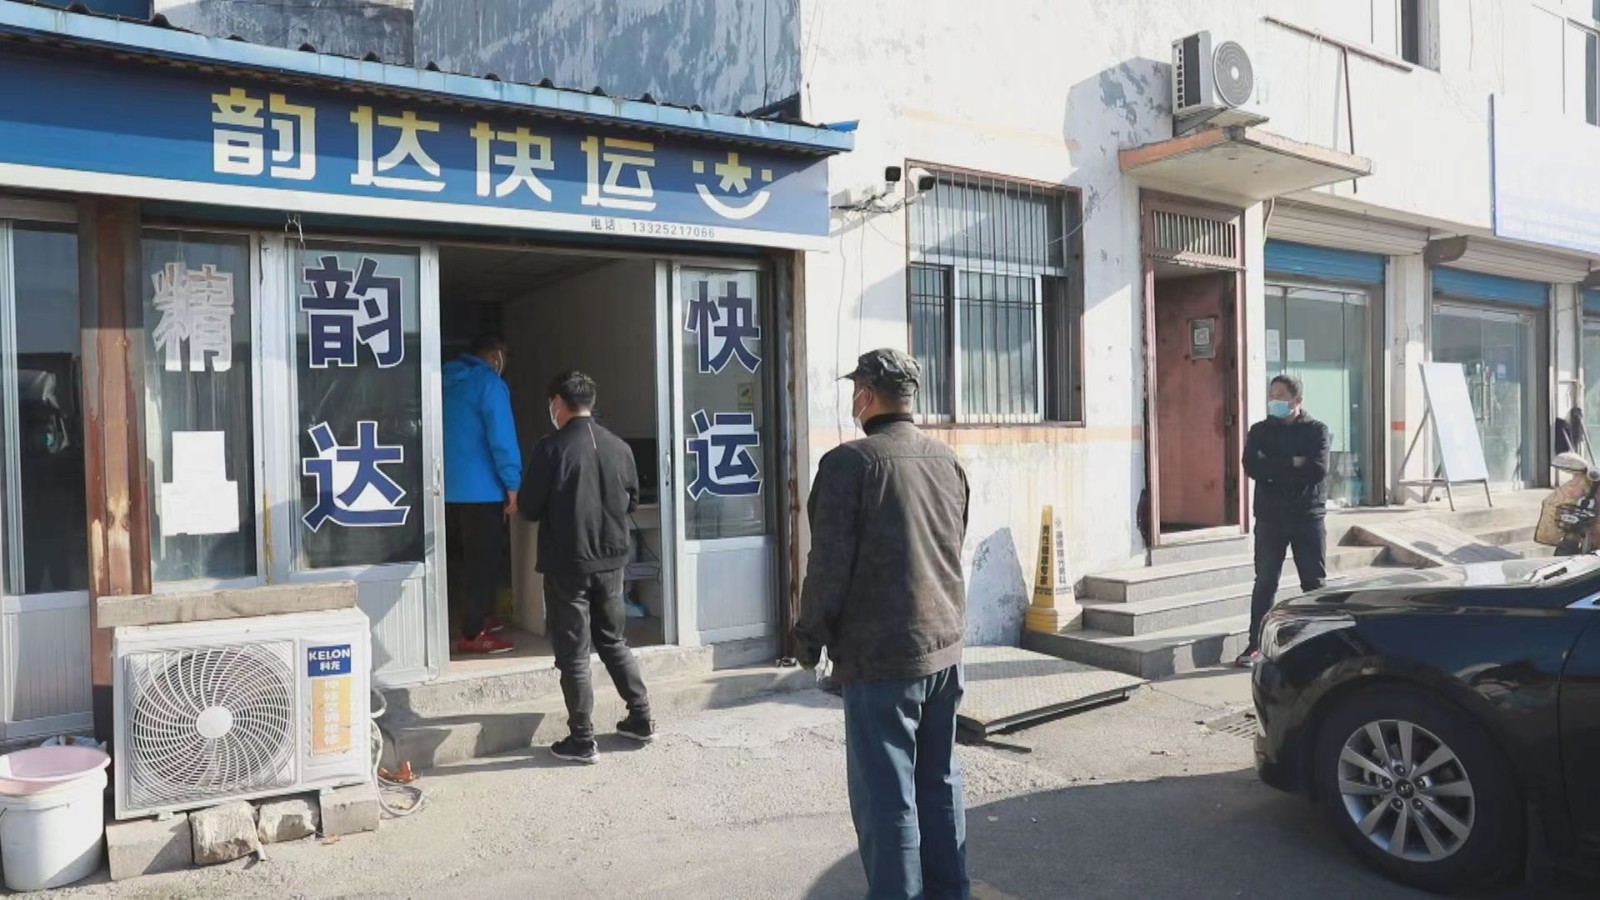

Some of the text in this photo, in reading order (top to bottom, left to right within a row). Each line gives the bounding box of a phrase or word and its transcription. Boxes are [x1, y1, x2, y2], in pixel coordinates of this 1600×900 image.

[211, 87, 657, 212] 韵达快运
[632, 222, 715, 238] 13325217066
[300, 255, 411, 534] 韵达
[684, 280, 762, 502] 快运
[308, 648, 351, 662] KELON
[319, 660, 341, 672] 科龙
